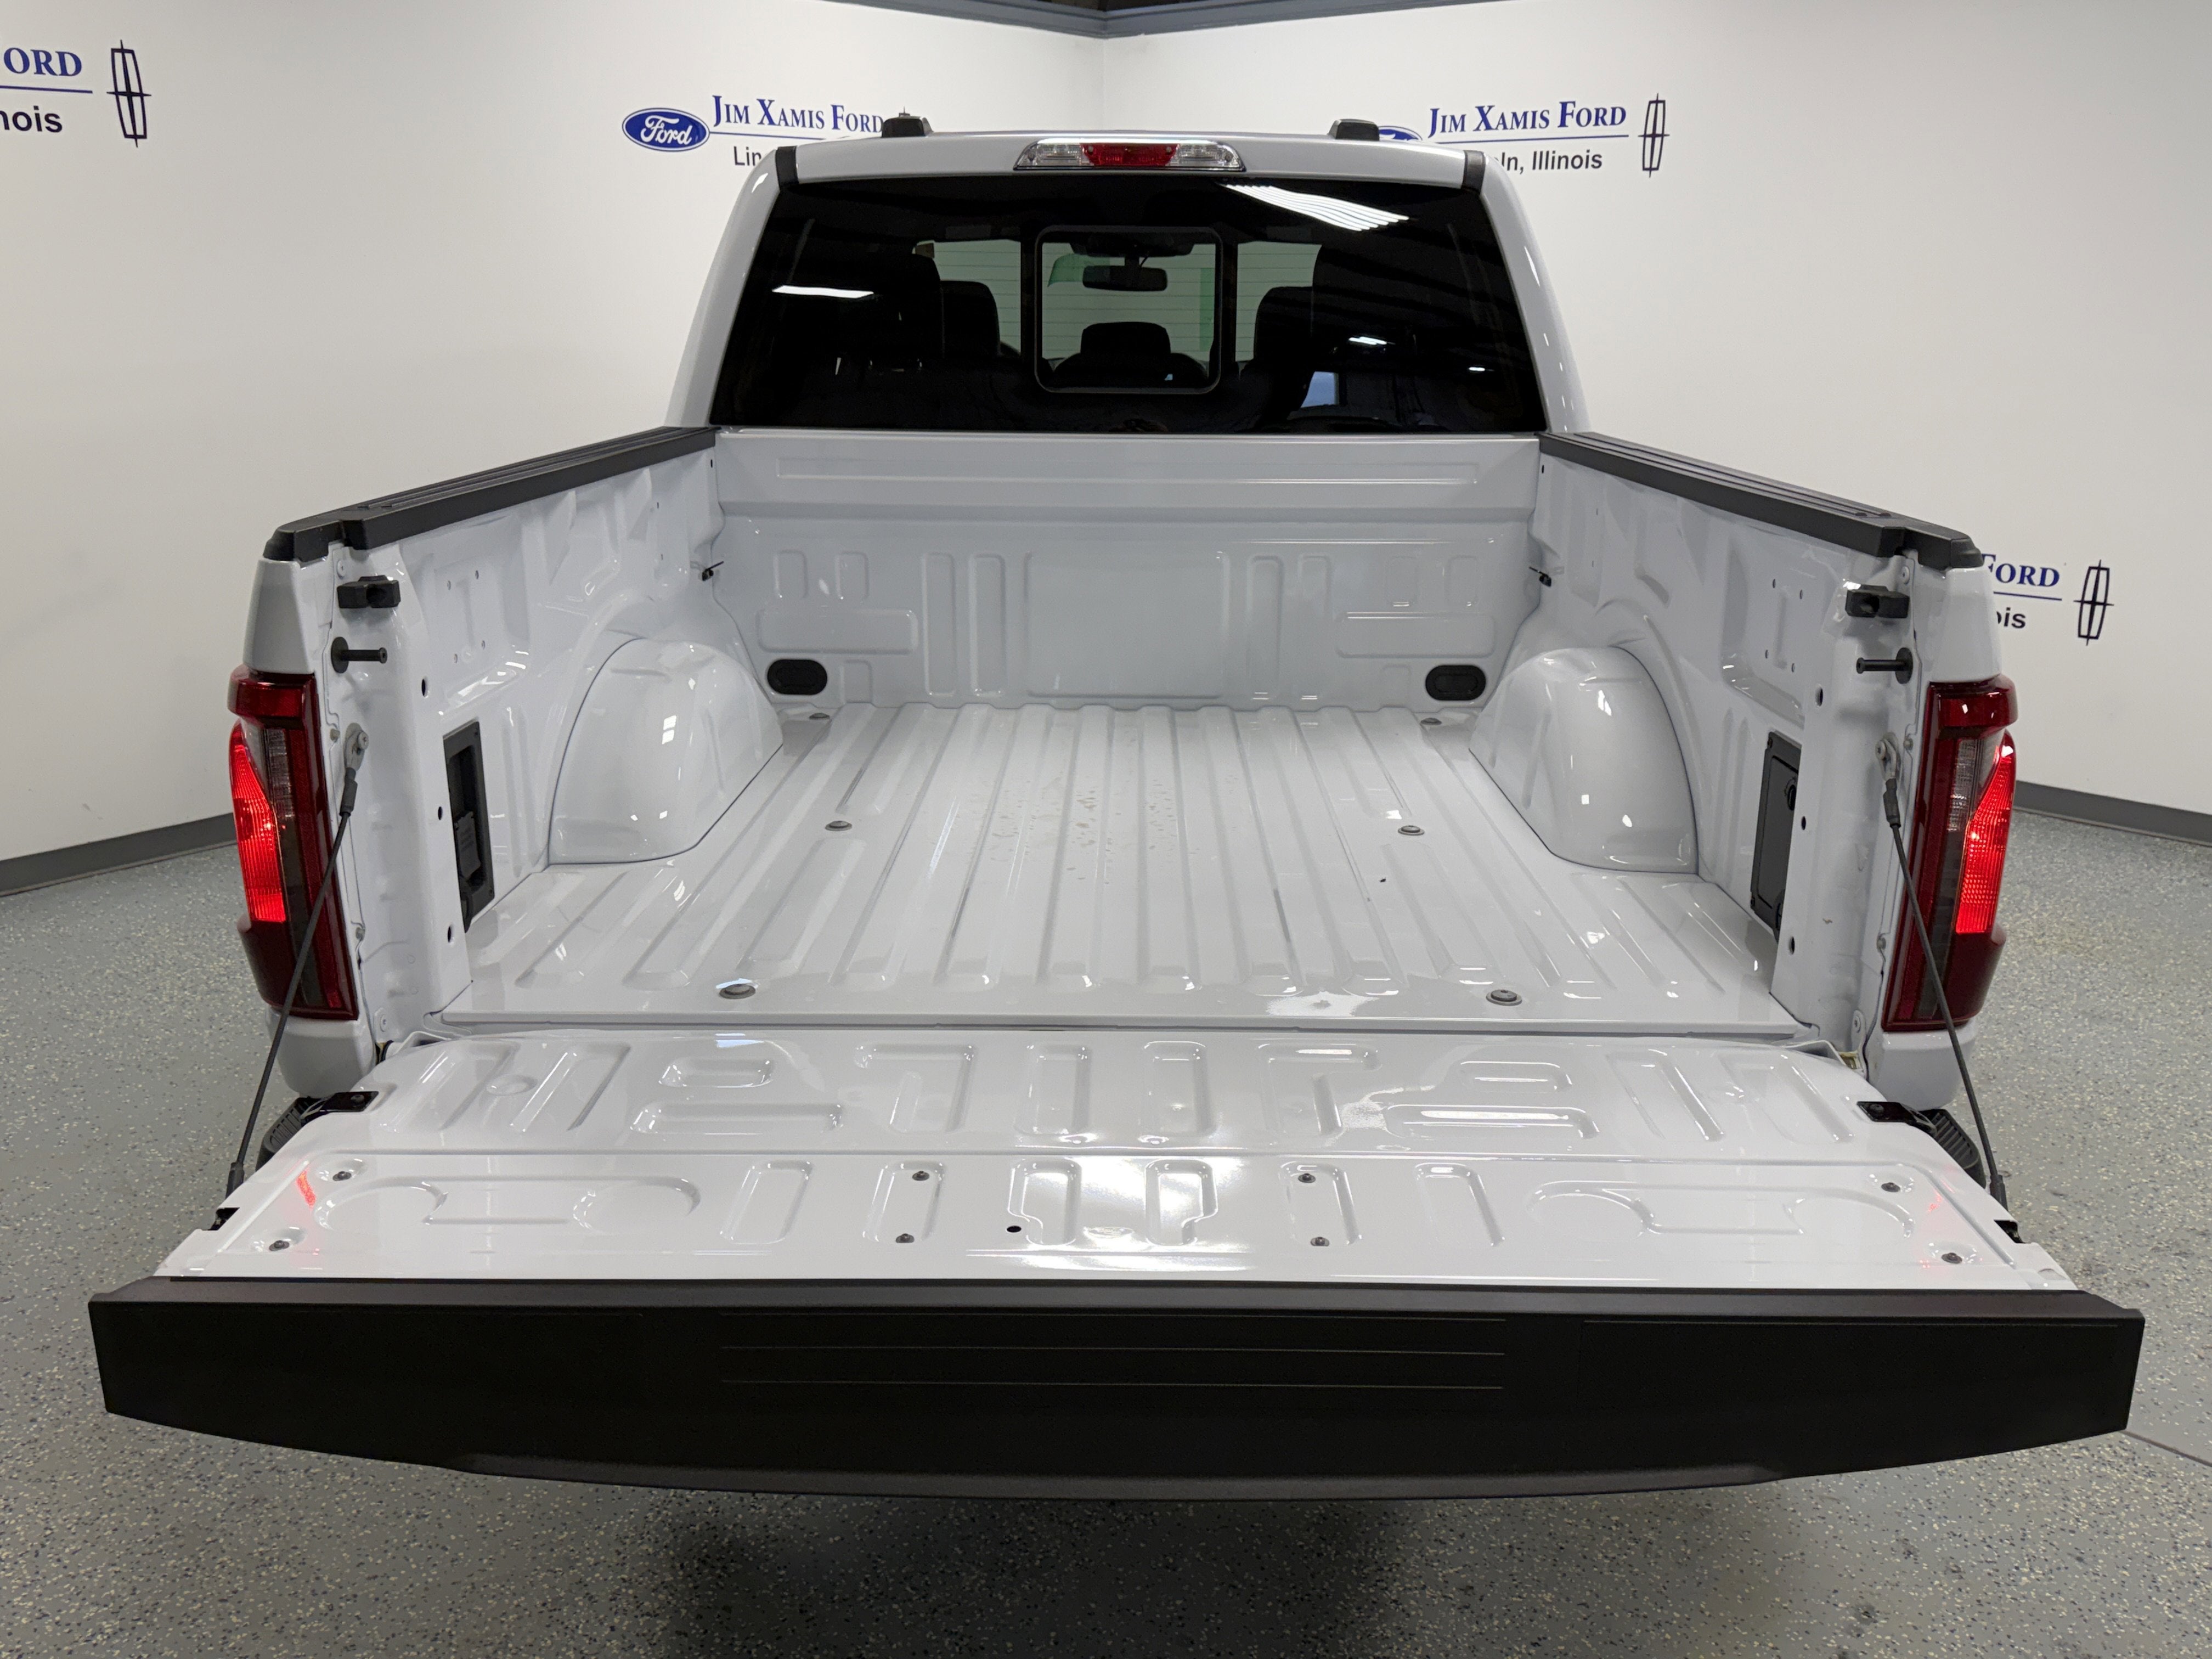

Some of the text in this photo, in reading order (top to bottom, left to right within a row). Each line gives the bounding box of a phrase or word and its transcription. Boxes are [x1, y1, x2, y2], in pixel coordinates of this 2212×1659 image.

[640, 115, 693, 145] Ford
[712, 95, 884, 133] JIM XAMIS FORD
[1427, 100, 1627, 138] JIM XAMIS FORD
[1532, 149, 1603, 170] Illinois
